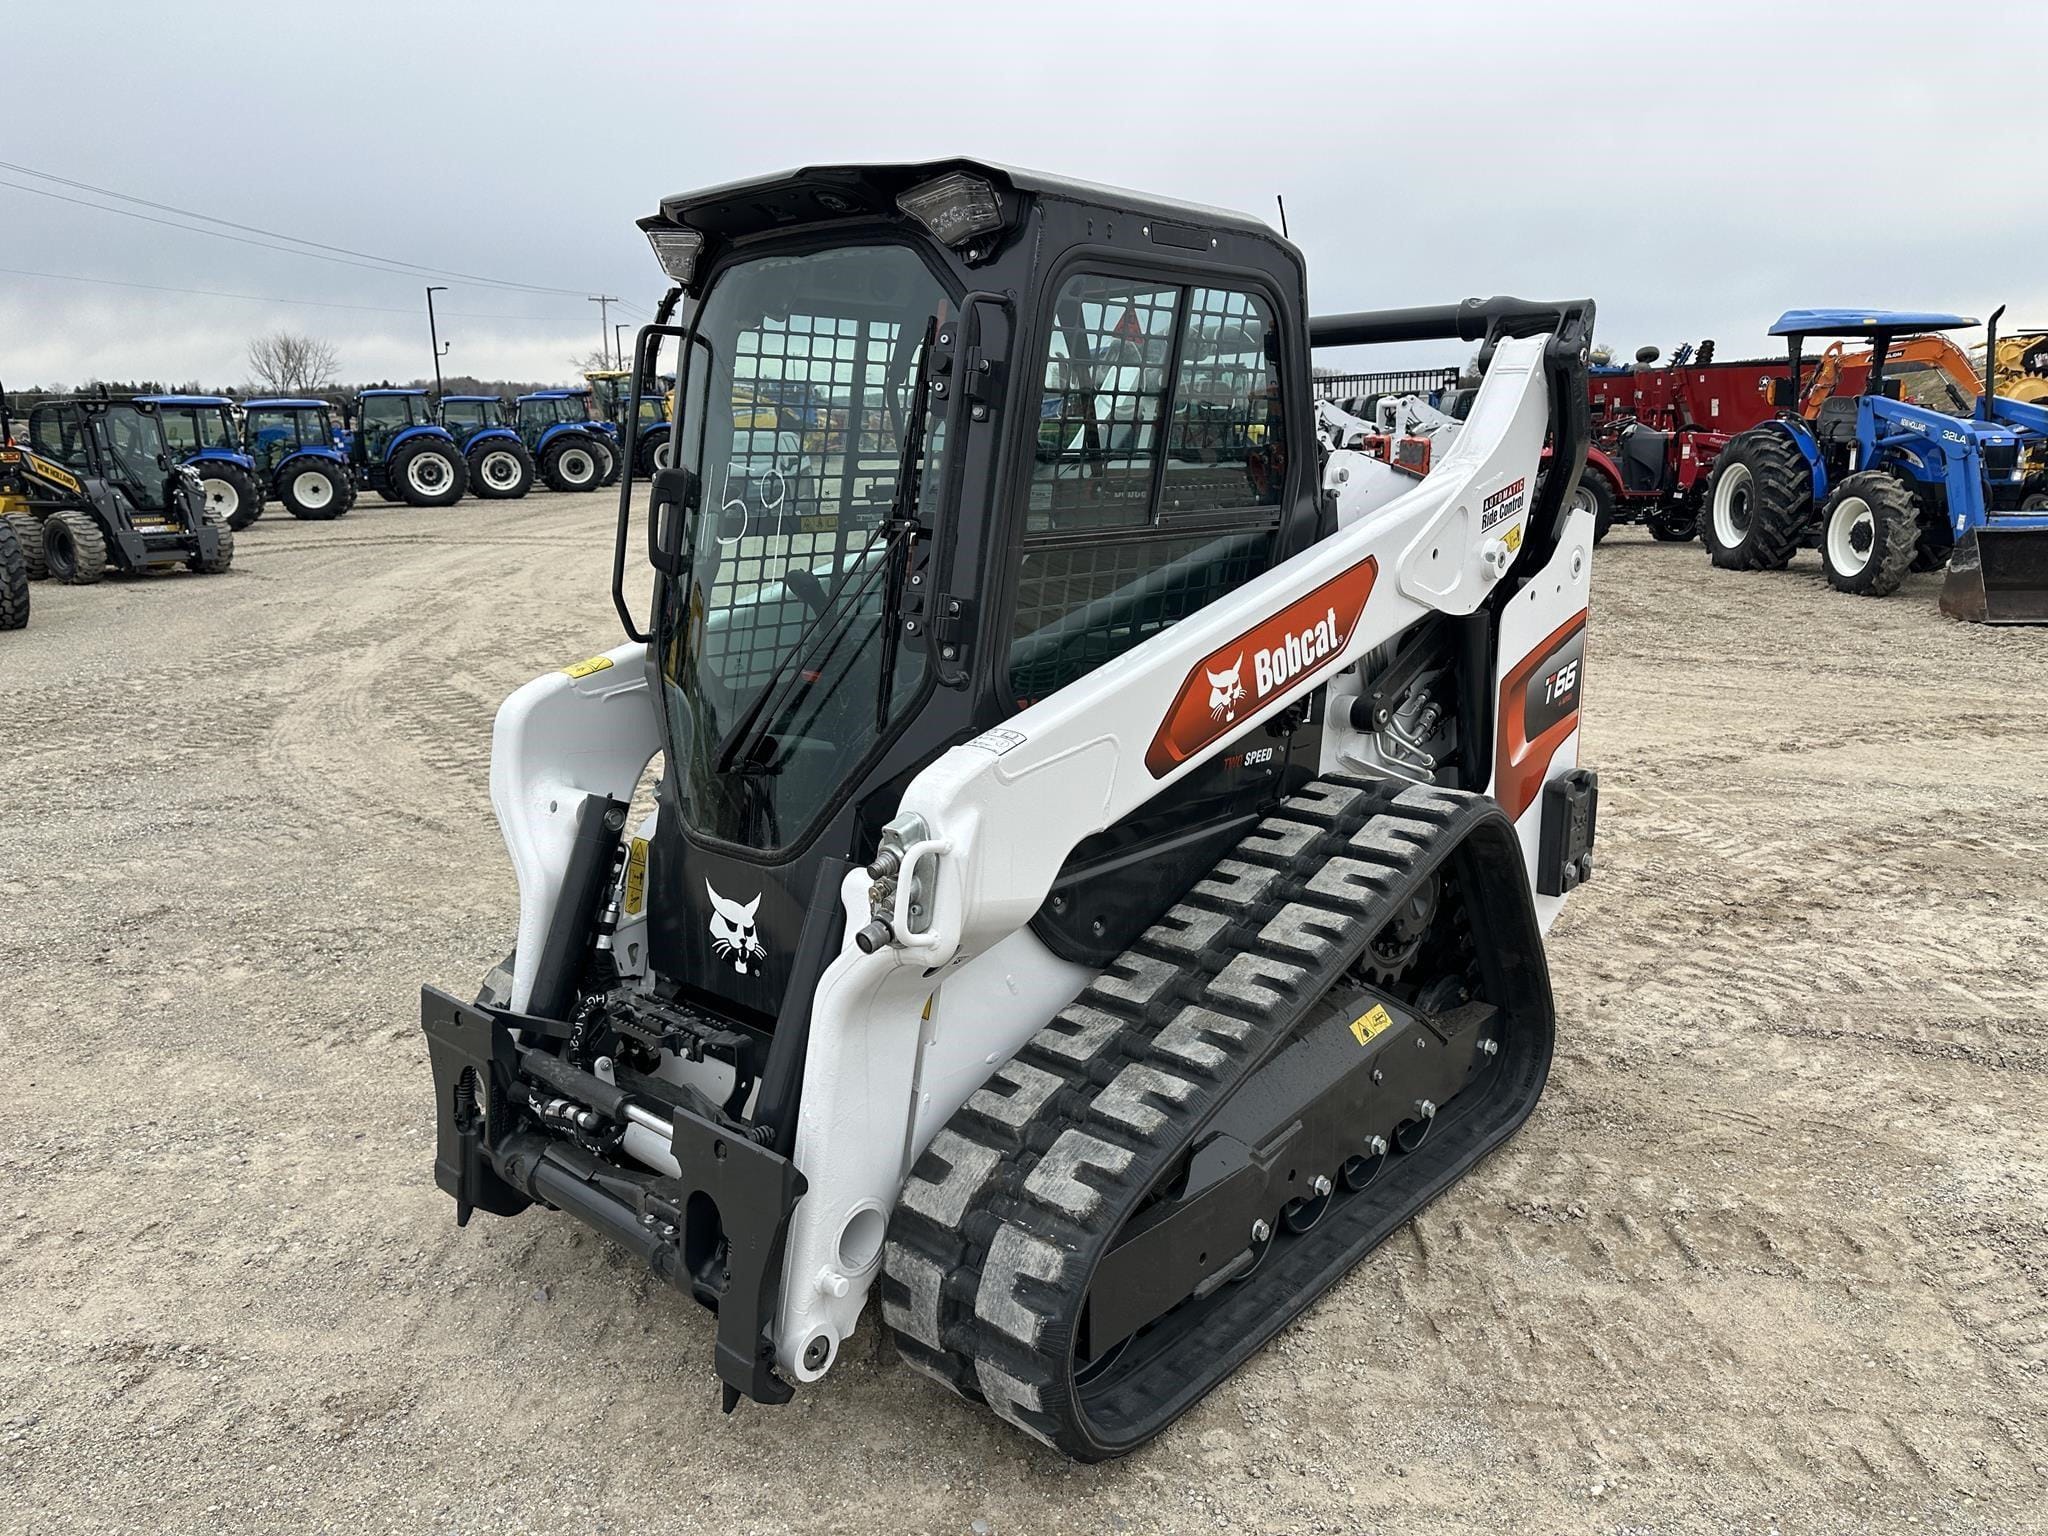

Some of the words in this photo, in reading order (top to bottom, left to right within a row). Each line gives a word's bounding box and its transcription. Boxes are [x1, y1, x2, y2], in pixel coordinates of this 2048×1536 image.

[1942, 429, 1967, 445] 32LA
[1482, 507, 1498, 531] Ride
[1499, 492, 1524, 519] Control
[1484, 480, 1524, 511] AUTOMATIC
[1253, 607, 1338, 698] Bobcat
[1545, 659, 1578, 705] T66
[1224, 754, 1244, 771] TWO
[1244, 747, 1273, 767] SPEED
